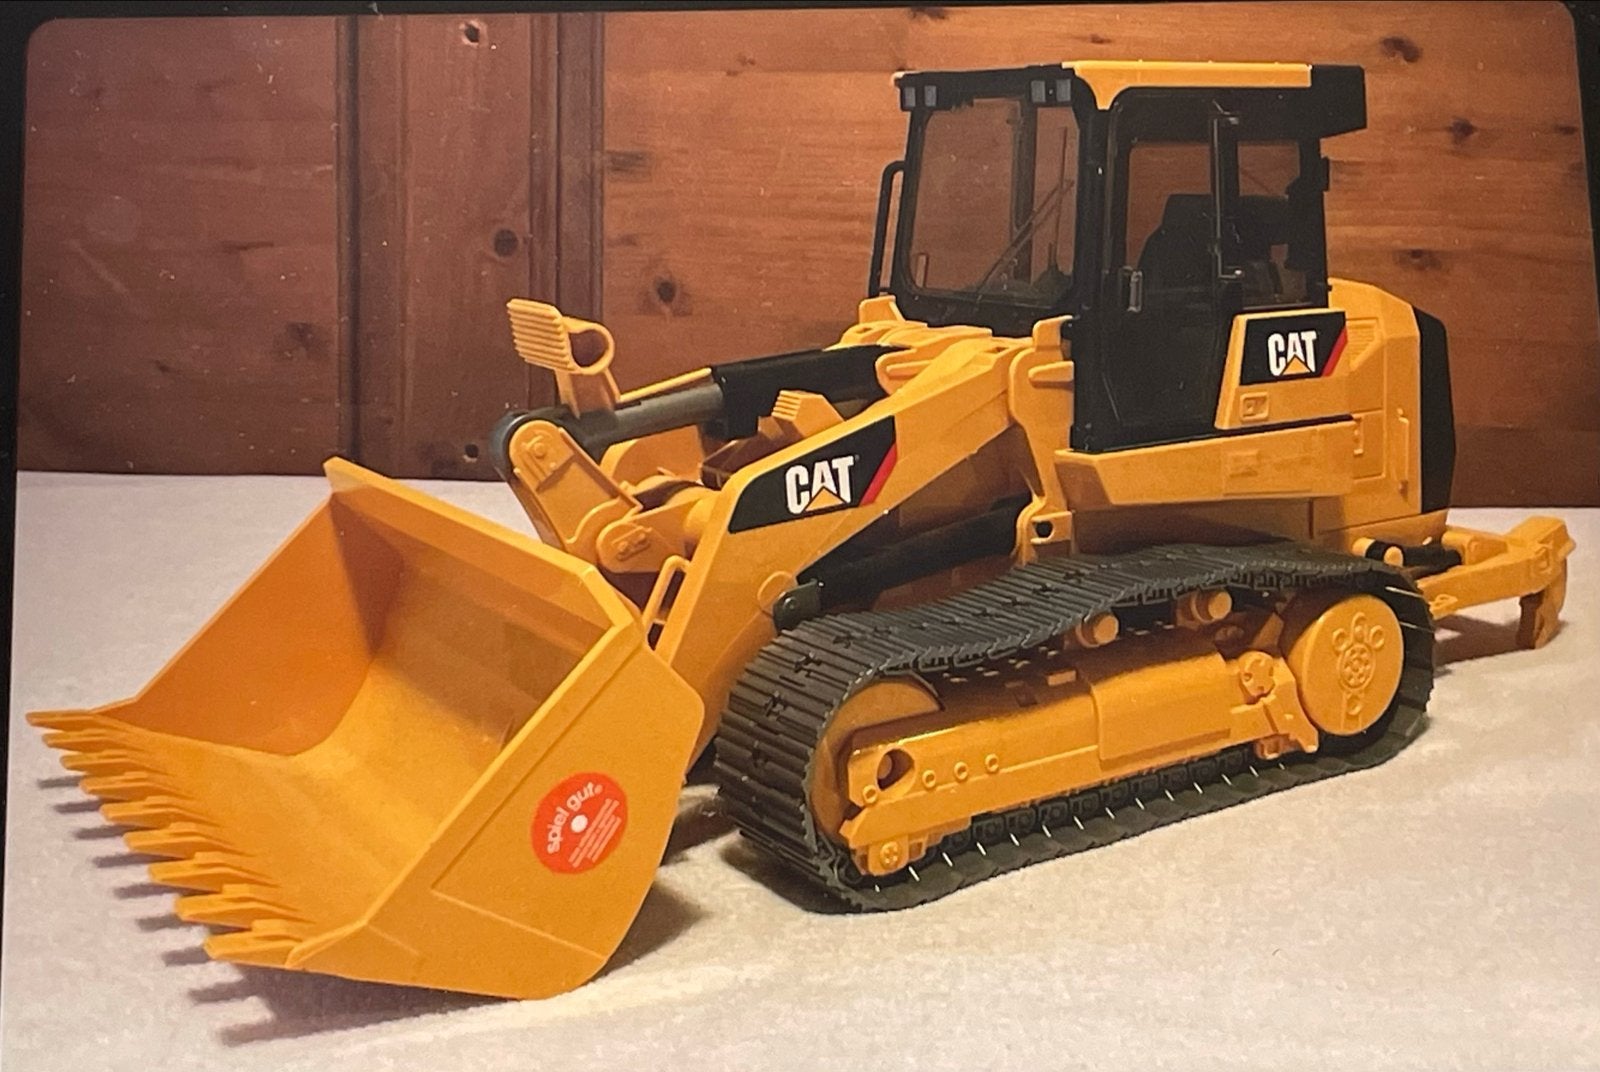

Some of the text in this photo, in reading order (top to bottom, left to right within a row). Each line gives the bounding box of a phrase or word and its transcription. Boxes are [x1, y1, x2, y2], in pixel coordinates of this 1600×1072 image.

[1267, 330, 1317, 377] CAT
[785, 455, 855, 515] CAT
[546, 806, 570, 854] spiel
